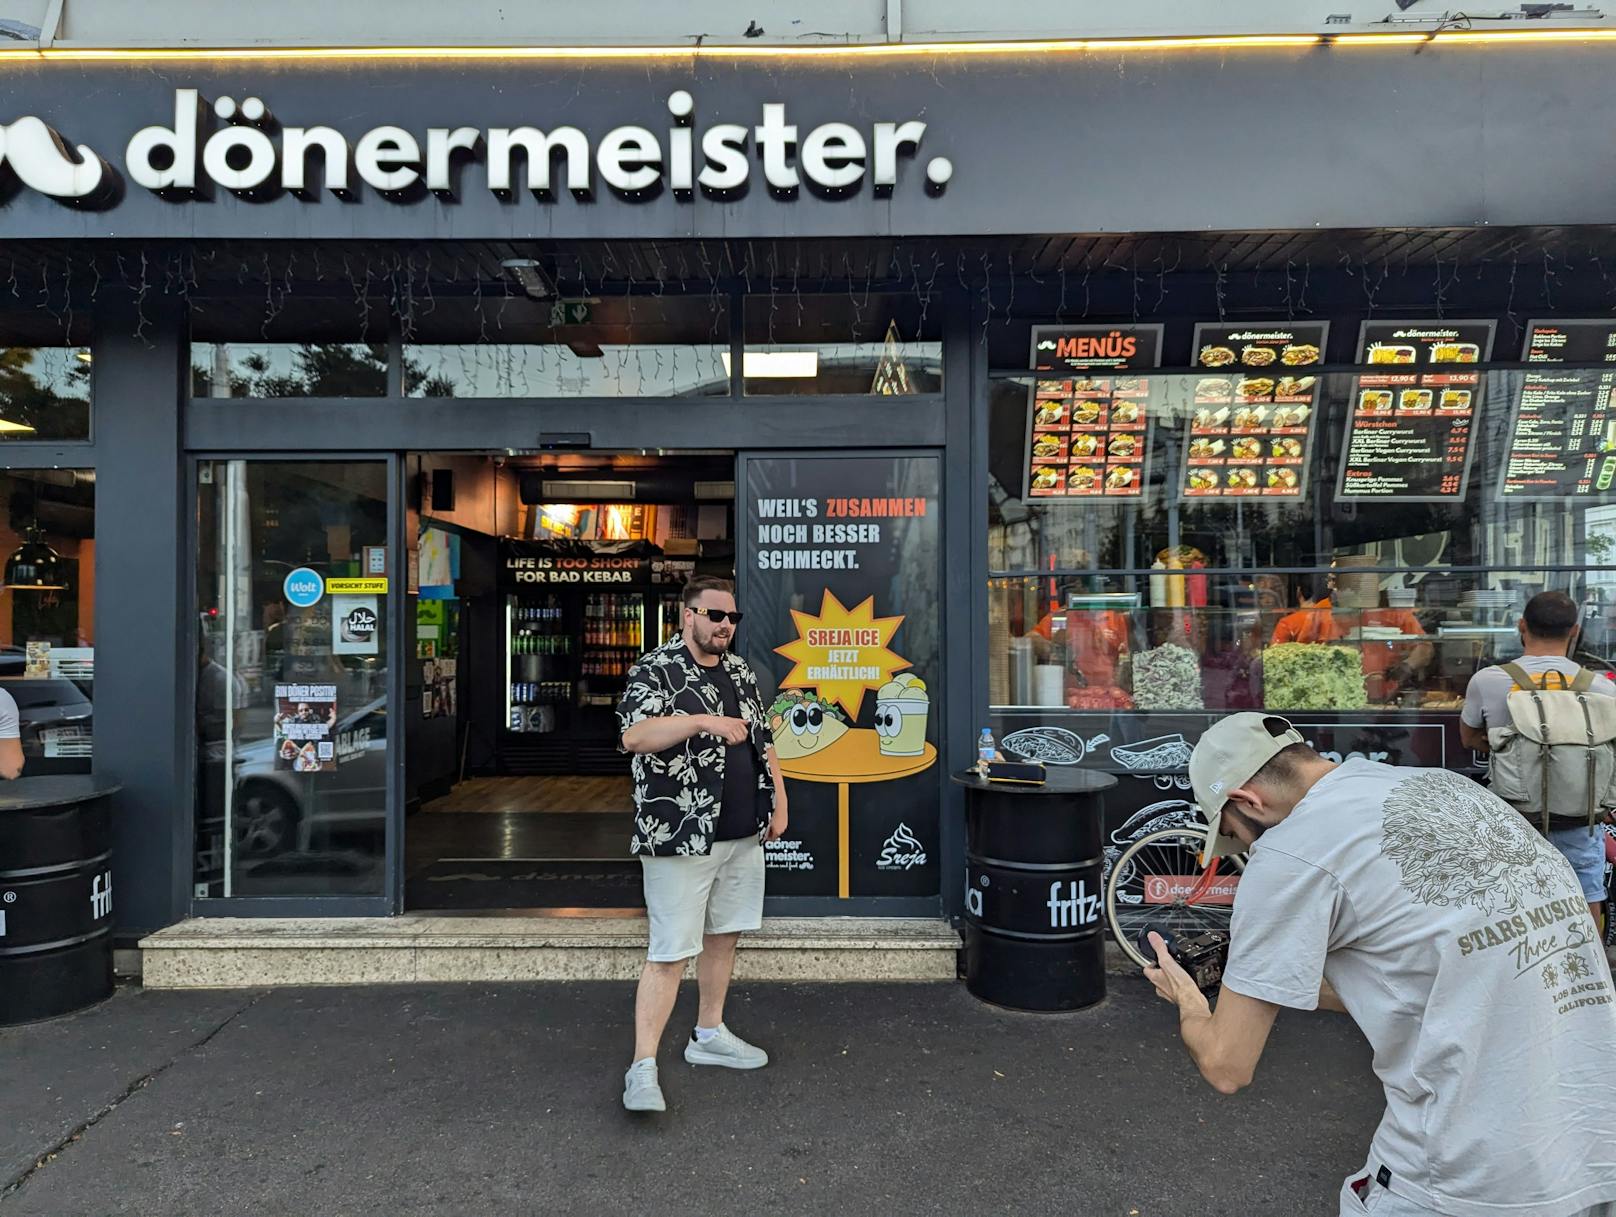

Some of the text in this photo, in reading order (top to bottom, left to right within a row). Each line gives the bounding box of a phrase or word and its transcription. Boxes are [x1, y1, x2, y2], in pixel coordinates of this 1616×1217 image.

[125, 88, 953, 192] dönermeister.
[1056, 331, 1136, 358] MENÜS
[826, 497, 927, 517] ZUSAMMEN
[758, 524, 880, 544] NOCH BESSER
[506, 558, 641, 568] LIFE IS TOO SHORT
[758, 550, 860, 570] SCHMECKT.
[516, 571, 632, 582] FOR BAD KEBAB
[291, 582, 317, 593] Wolt
[808, 629, 880, 647] SREJA ICE
[828, 649, 859, 663] JETZT
[807, 664, 880, 680] ERHÄLTLICH!
[765, 850, 814, 862] meister.
[876, 847, 927, 870] Sreja
[1457, 914, 1527, 956] STARS
[1508, 935, 1558, 969] Three
[1552, 990, 1568, 1004] LOS
